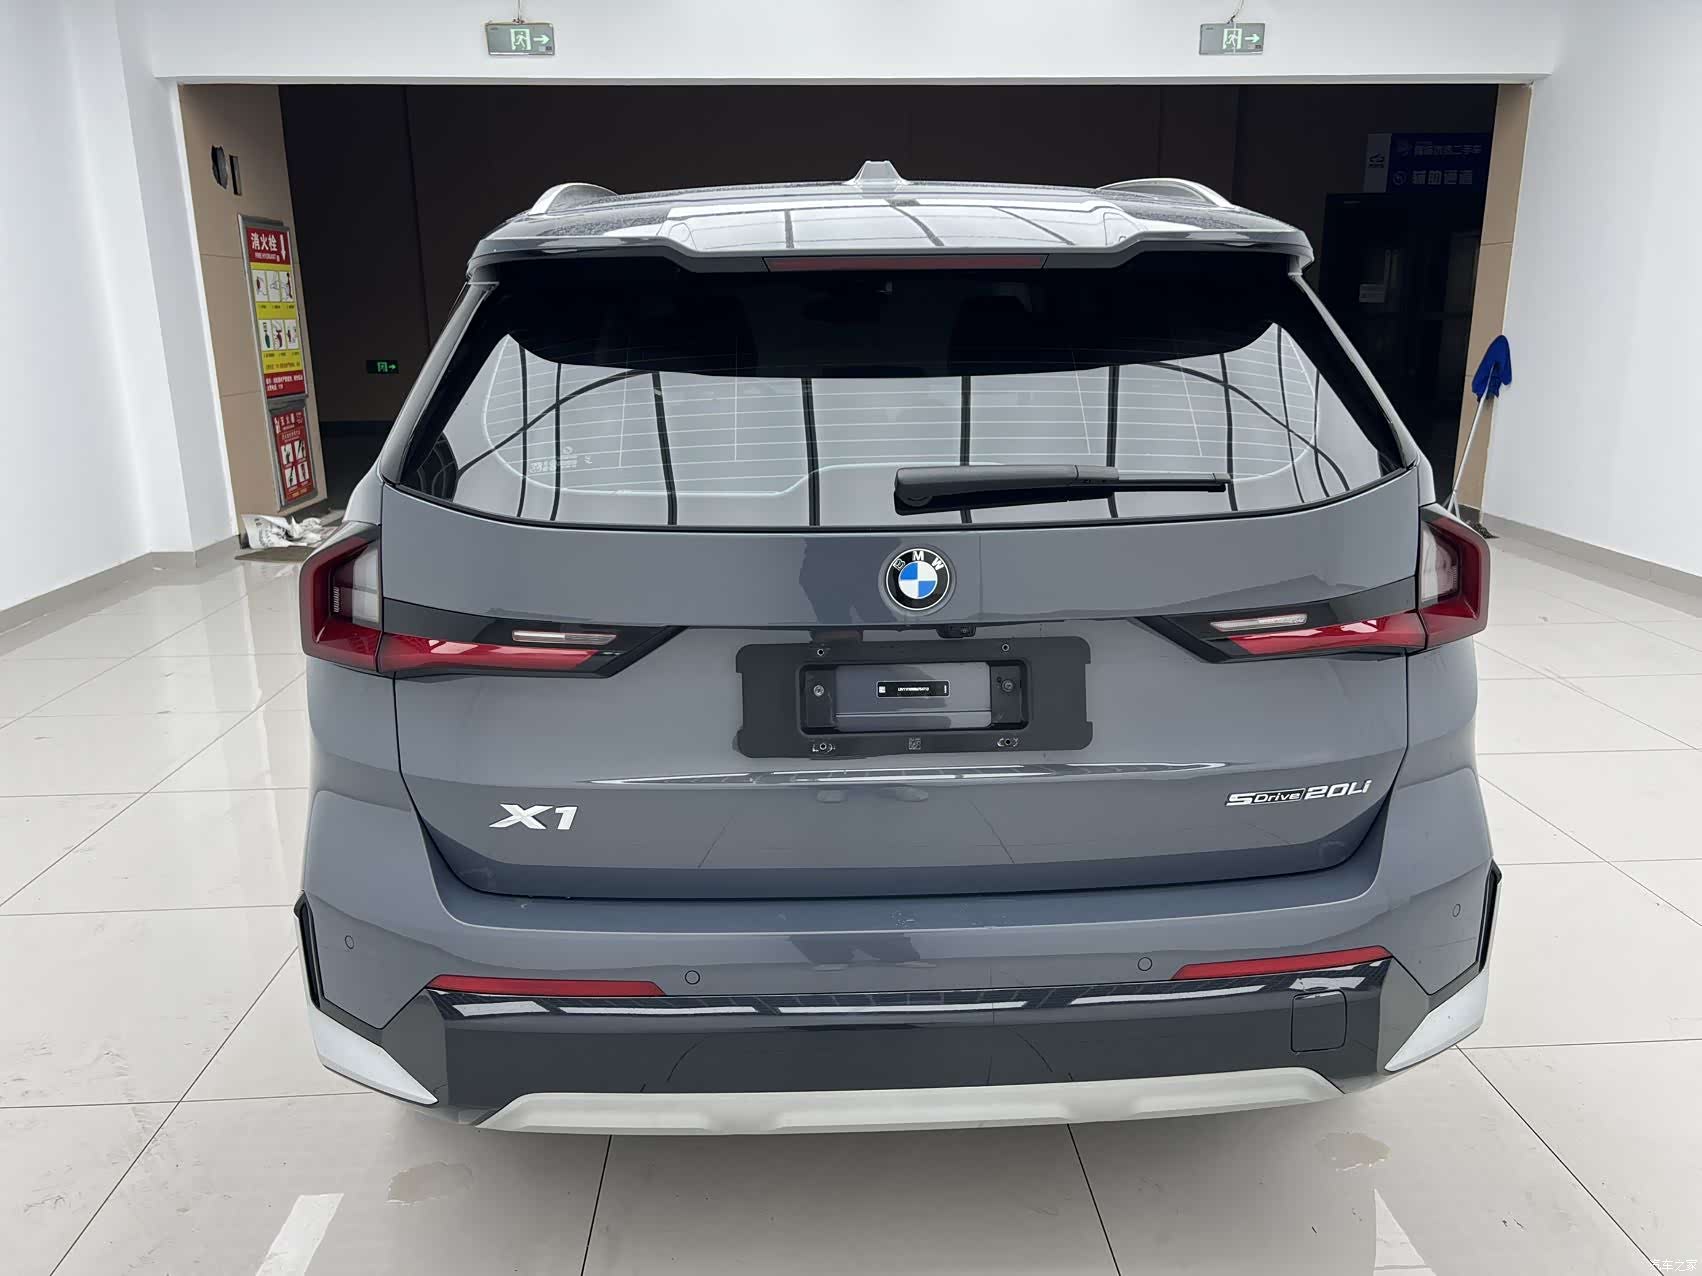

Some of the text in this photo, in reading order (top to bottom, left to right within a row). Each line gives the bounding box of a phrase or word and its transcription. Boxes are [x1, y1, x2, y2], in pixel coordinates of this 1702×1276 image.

[250, 232, 278, 251] 消火栓
[892, 550, 945, 572] BMW
[488, 803, 578, 830] X1
